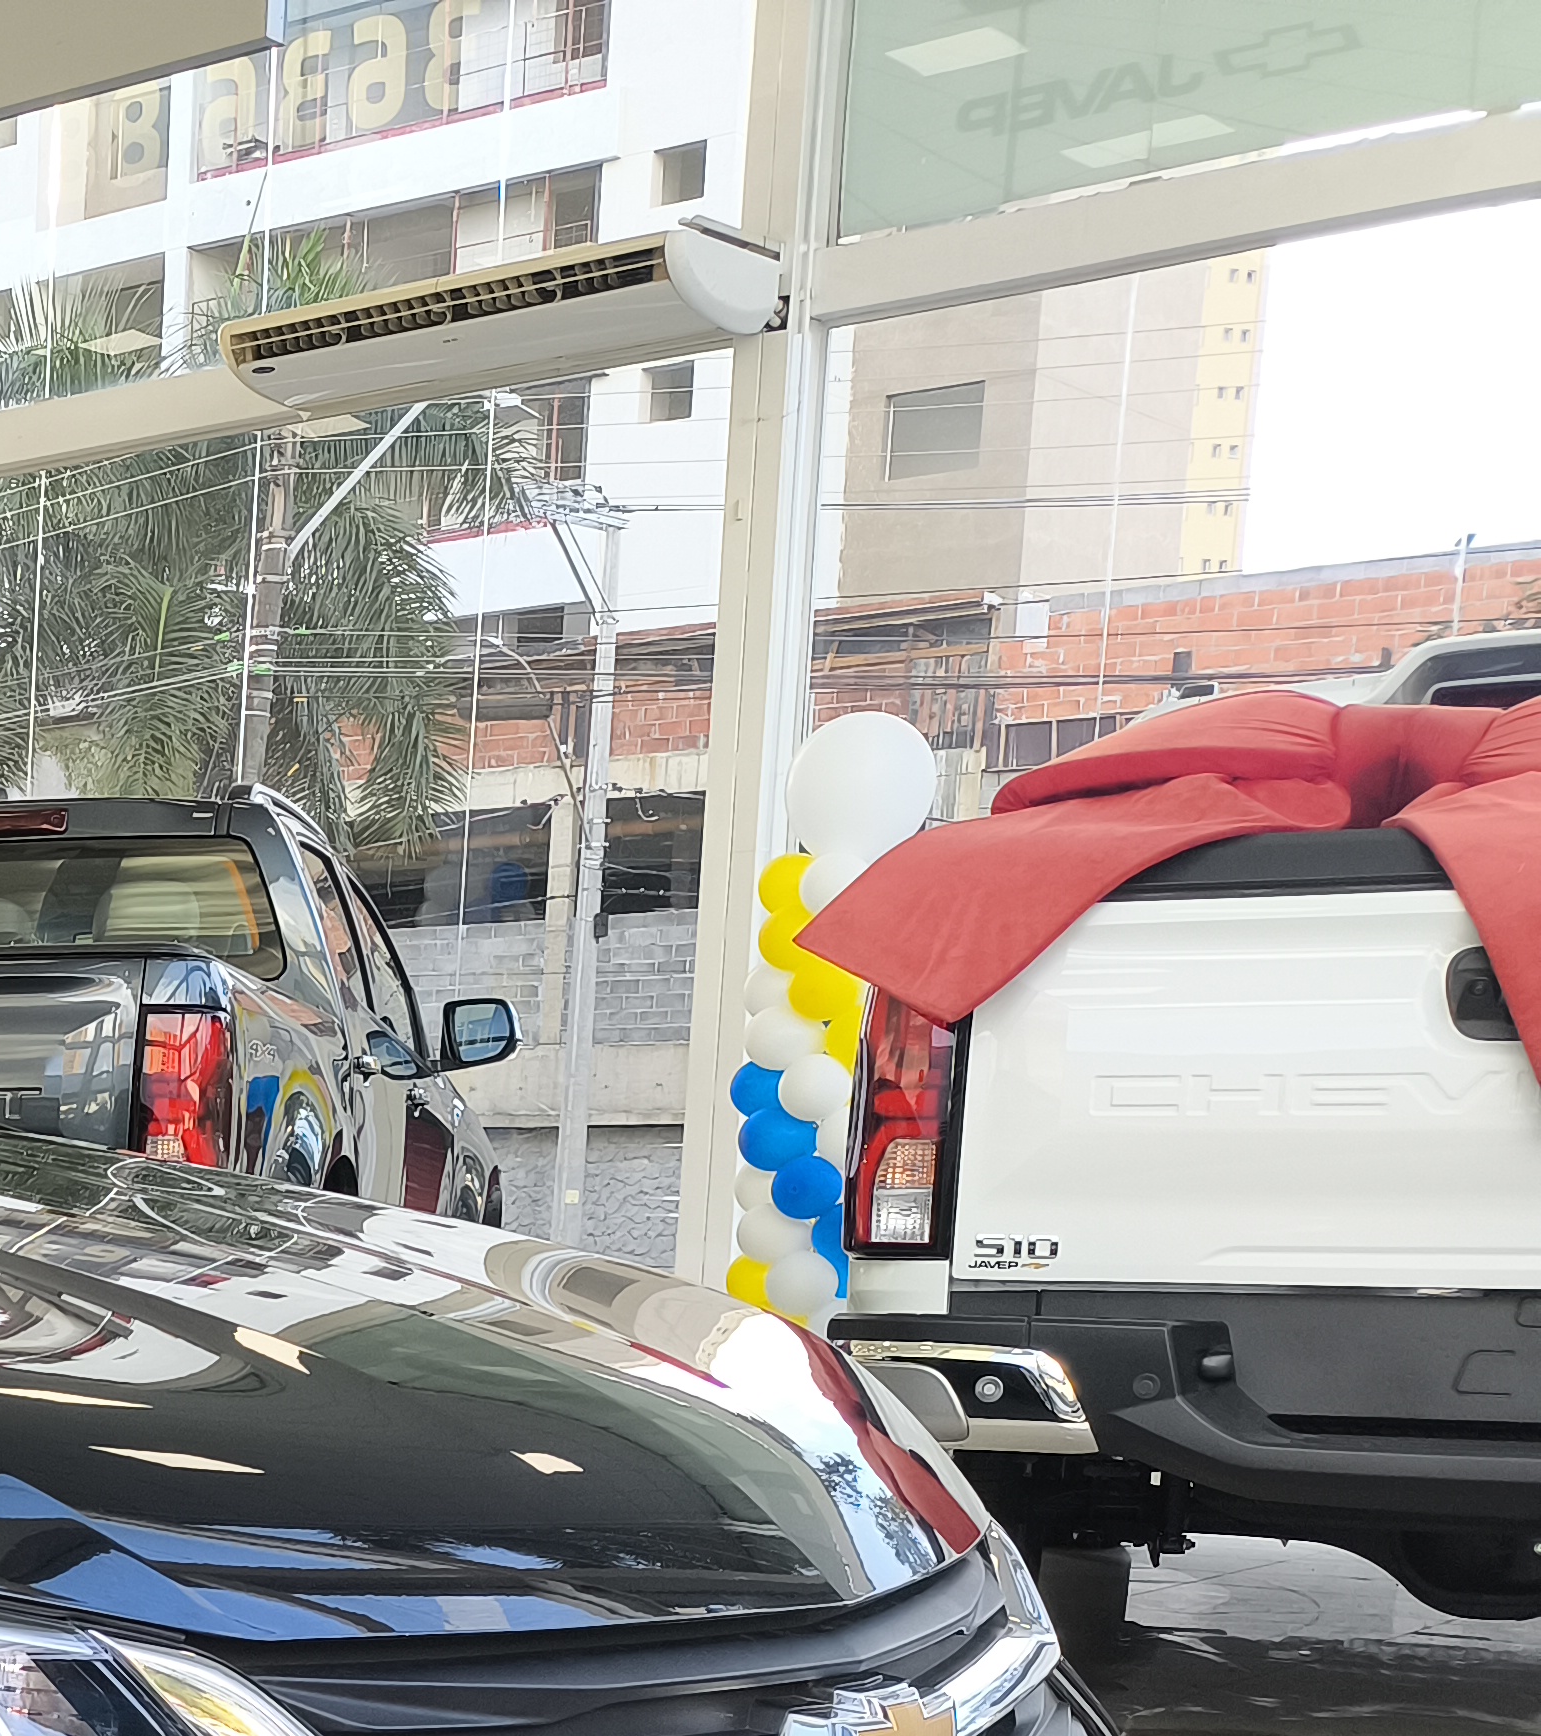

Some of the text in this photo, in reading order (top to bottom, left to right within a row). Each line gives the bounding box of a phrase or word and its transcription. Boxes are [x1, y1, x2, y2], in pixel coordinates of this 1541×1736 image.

[1089, 1070, 1541, 1118] CHEV
[973, 1233, 1060, 1260] S10
[968, 1260, 1019, 1270] JAVEP
